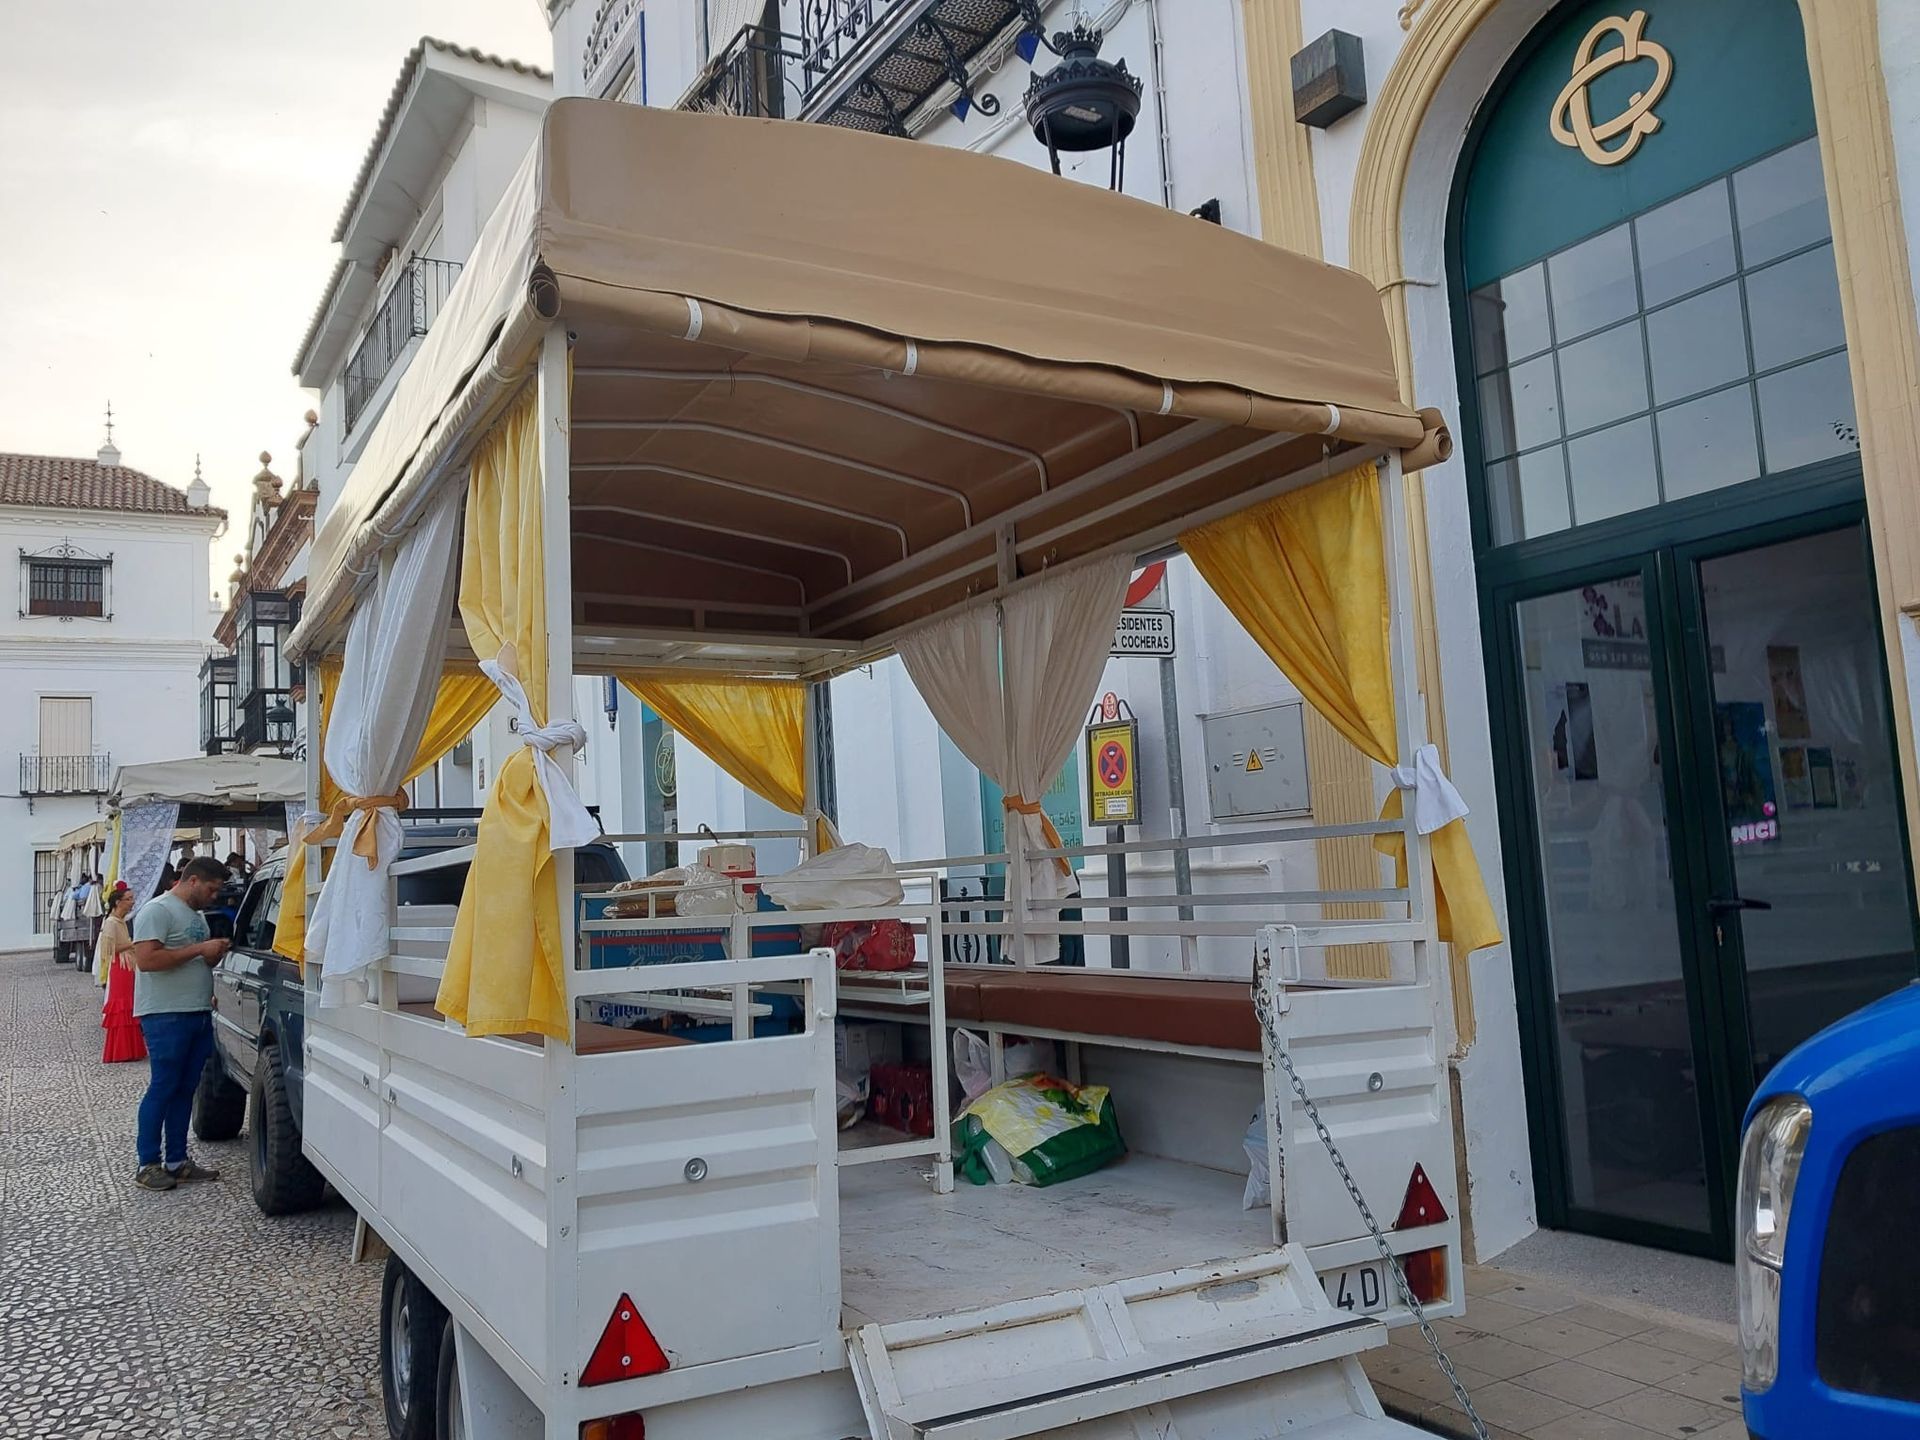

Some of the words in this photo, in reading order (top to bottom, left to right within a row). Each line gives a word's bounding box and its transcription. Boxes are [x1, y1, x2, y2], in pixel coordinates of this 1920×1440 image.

[1117, 617, 1163, 631] SIDENTES
[1121, 636, 1169, 649] COCHERAS
[1319, 1268, 1379, 1310] 4D
